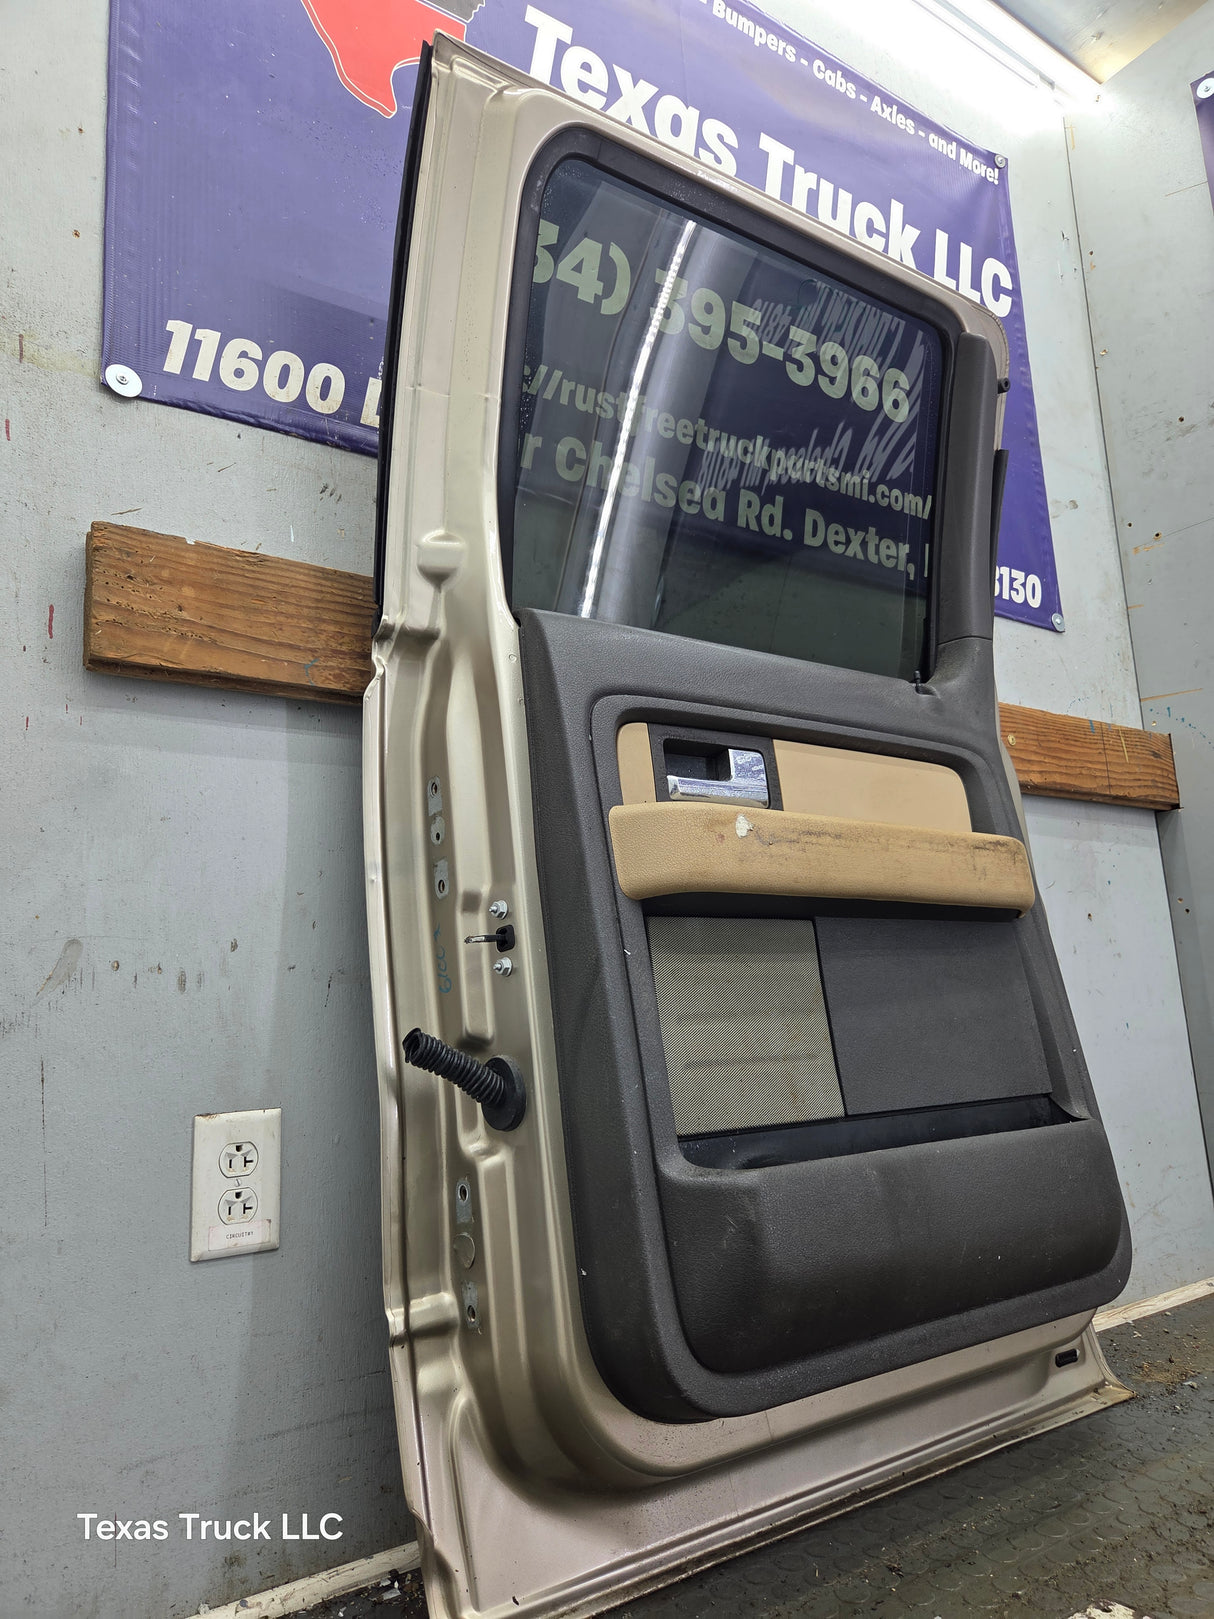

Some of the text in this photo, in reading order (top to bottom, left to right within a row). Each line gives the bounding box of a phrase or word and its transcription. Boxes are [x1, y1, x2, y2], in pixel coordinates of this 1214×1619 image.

[524, 4, 1013, 318] Texas Truck LLC
[712, 0, 797, 62] Bumpers
[812, 59, 857, 98] Cabs
[870, 95, 915, 135] Axles
[929, 132, 957, 161] and
[959, 147, 999, 185] More!
[162, 319, 346, 415] 11600
[649, 268, 911, 424] 395-3966
[555, 436, 727, 522] Chelsea
[737, 489, 794, 541] Rd.
[803, 507, 916, 580] Dexter,
[226, 1231, 254, 1240] CIRCUITRY
